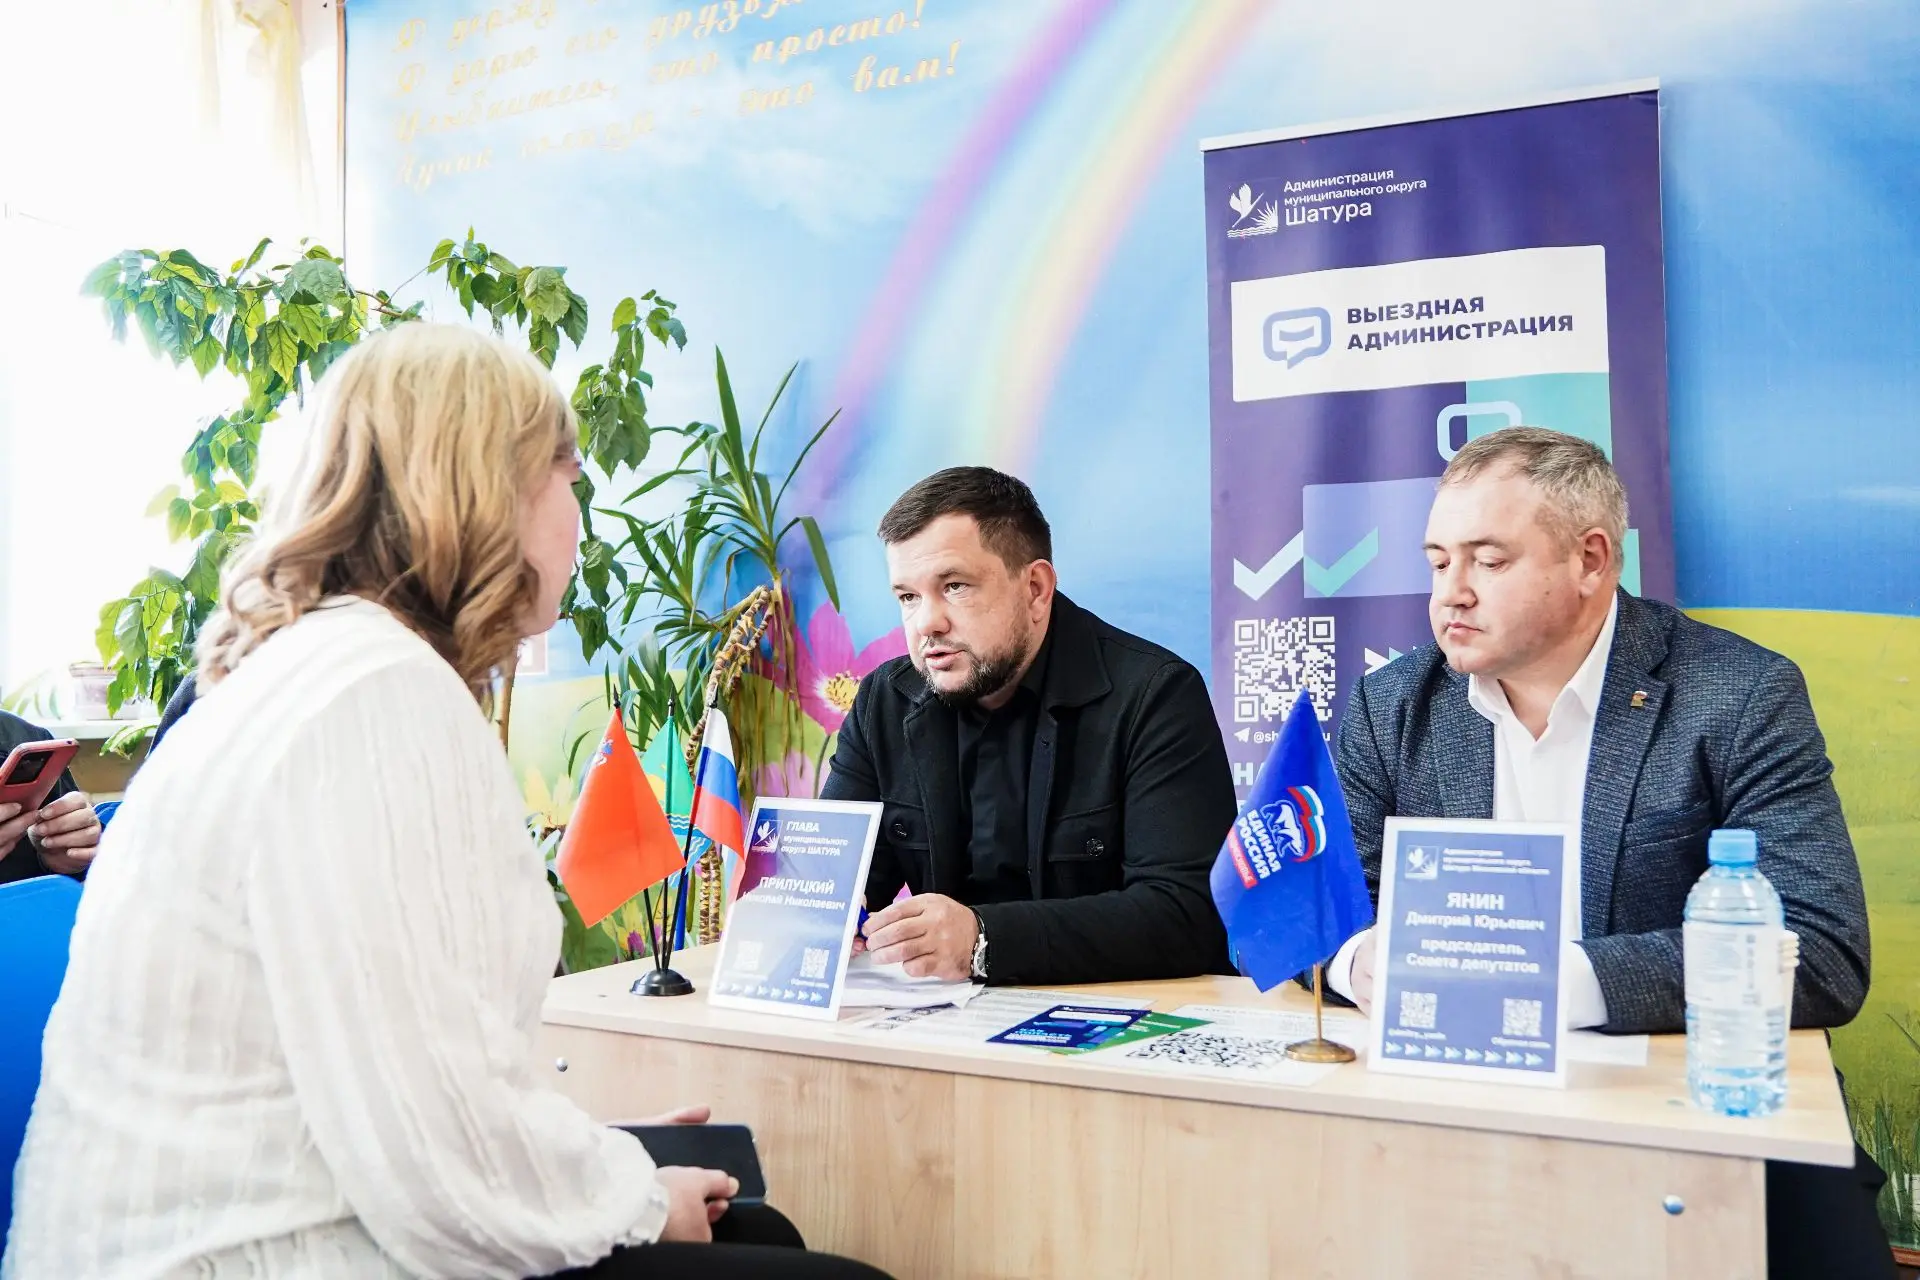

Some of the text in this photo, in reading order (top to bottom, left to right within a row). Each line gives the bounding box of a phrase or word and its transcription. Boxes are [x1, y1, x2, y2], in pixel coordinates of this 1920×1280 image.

[752, 0, 925, 64] просто!
[853, 40, 961, 94] вам!
[1284, 169, 1394, 193] Администрация
[1284, 178, 1427, 206] муниципального округа
[1285, 200, 1372, 226] Шатура
[1347, 296, 1484, 325] ВЫЕЗДНАЯ
[1347, 315, 1573, 352] АДМИНИСТРАЦИЯ
[786, 821, 819, 832] ГЛАВА
[807, 846, 841, 856] ШАТУРА
[1236, 816, 1271, 879] РОССИЯ
[1247, 809, 1282, 873] ЕДИНАЯ
[759, 876, 835, 895] ПРИЛУЦКИЙ
[785, 896, 846, 910] Николаевич
[1446, 892, 1505, 911] ЯНИН
[1405, 911, 1546, 932] Дмитрий Юрьевич
[1421, 938, 1527, 956] председатель
[1406, 953, 1540, 974] Совета депутатов
